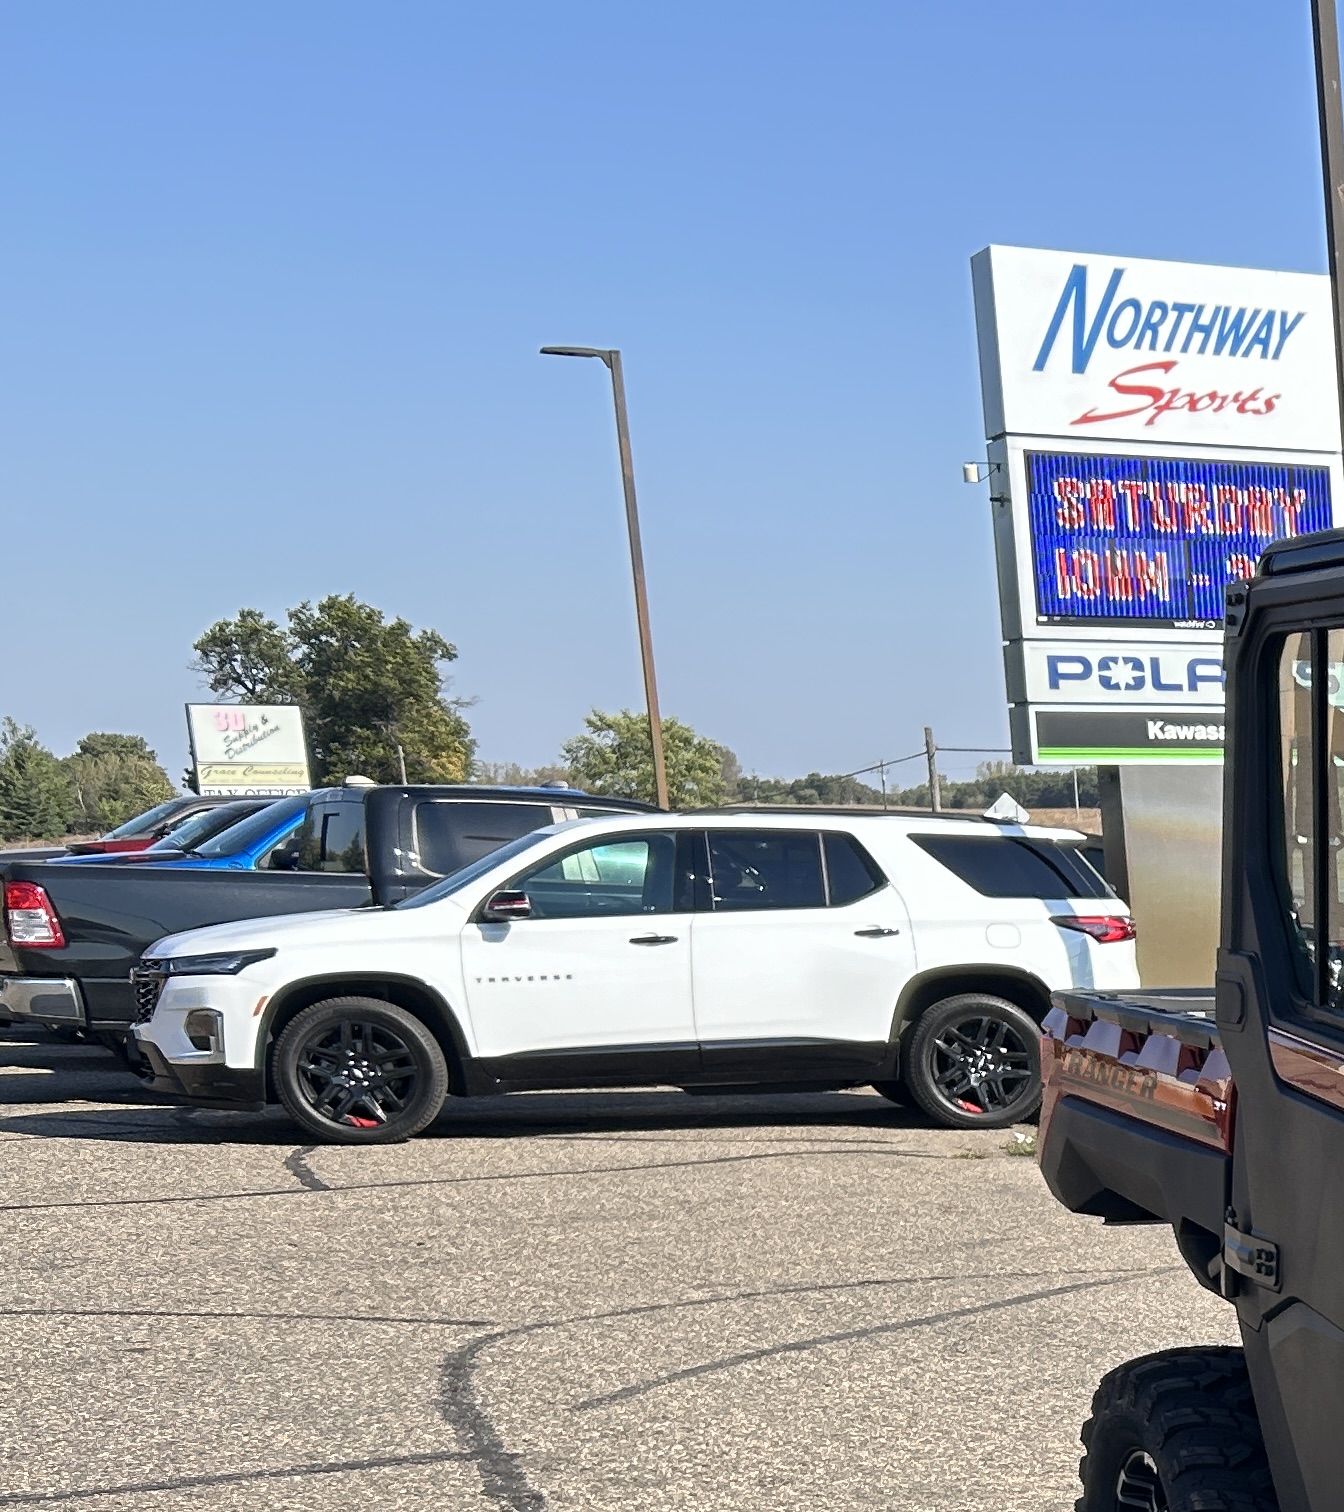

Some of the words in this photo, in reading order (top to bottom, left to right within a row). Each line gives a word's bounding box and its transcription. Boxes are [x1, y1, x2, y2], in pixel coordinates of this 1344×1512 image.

[1069, 360, 1282, 426] Sports
[1054, 476, 1306, 538] SATURDAY
[1055, 547, 1169, 601] 10AM
[223, 723, 259, 748] Supply
[260, 713, 268, 725] &
[224, 725, 280, 760] Distribution
[200, 764, 238, 779] Grace
[476, 974, 573, 983] TRAVERSE
[1067, 1050, 1158, 1100] RANGER
